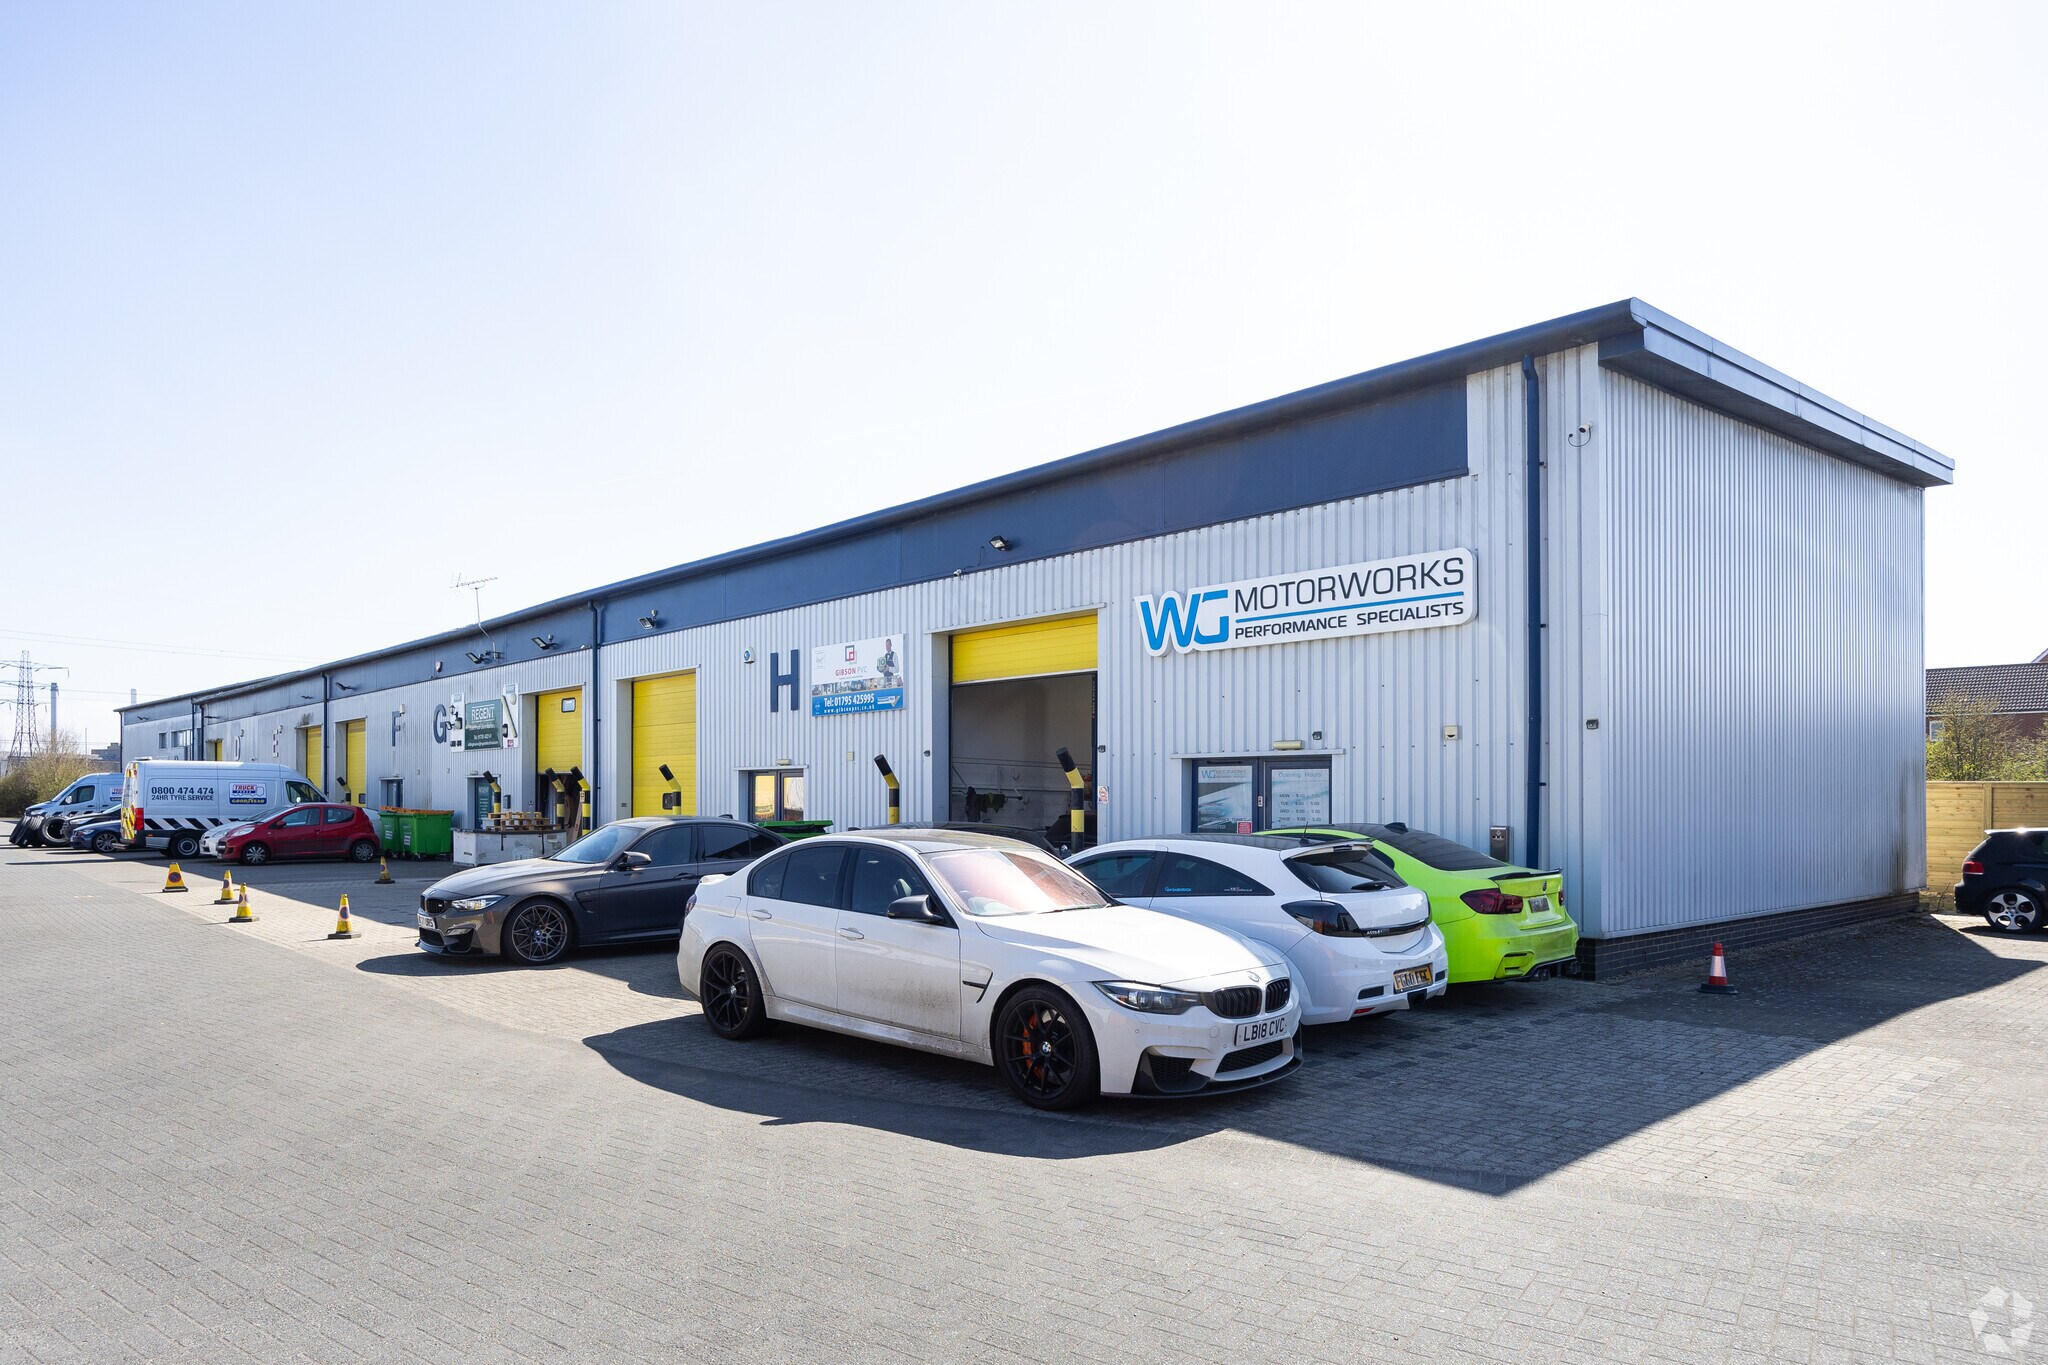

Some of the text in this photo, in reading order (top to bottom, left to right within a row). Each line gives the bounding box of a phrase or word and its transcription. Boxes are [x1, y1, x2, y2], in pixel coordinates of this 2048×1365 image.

[1140, 557, 1465, 651] WG MOTORWORKS
[1235, 601, 1465, 640] PERFORMANCE SPECIALISTS
[770, 649, 799, 712] H
[835, 666, 867, 677] GIBSON PVC
[471, 706, 494, 720] REGENT
[823, 697, 834, 708] Tel:
[834, 696, 851, 707] 01795
[852, 693, 875, 705] 425995
[392, 711, 401, 747] F
[433, 704, 447, 744] G
[151, 786, 214, 795] 0800 474 474
[1243, 1017, 1285, 1042] LB18 CVC
